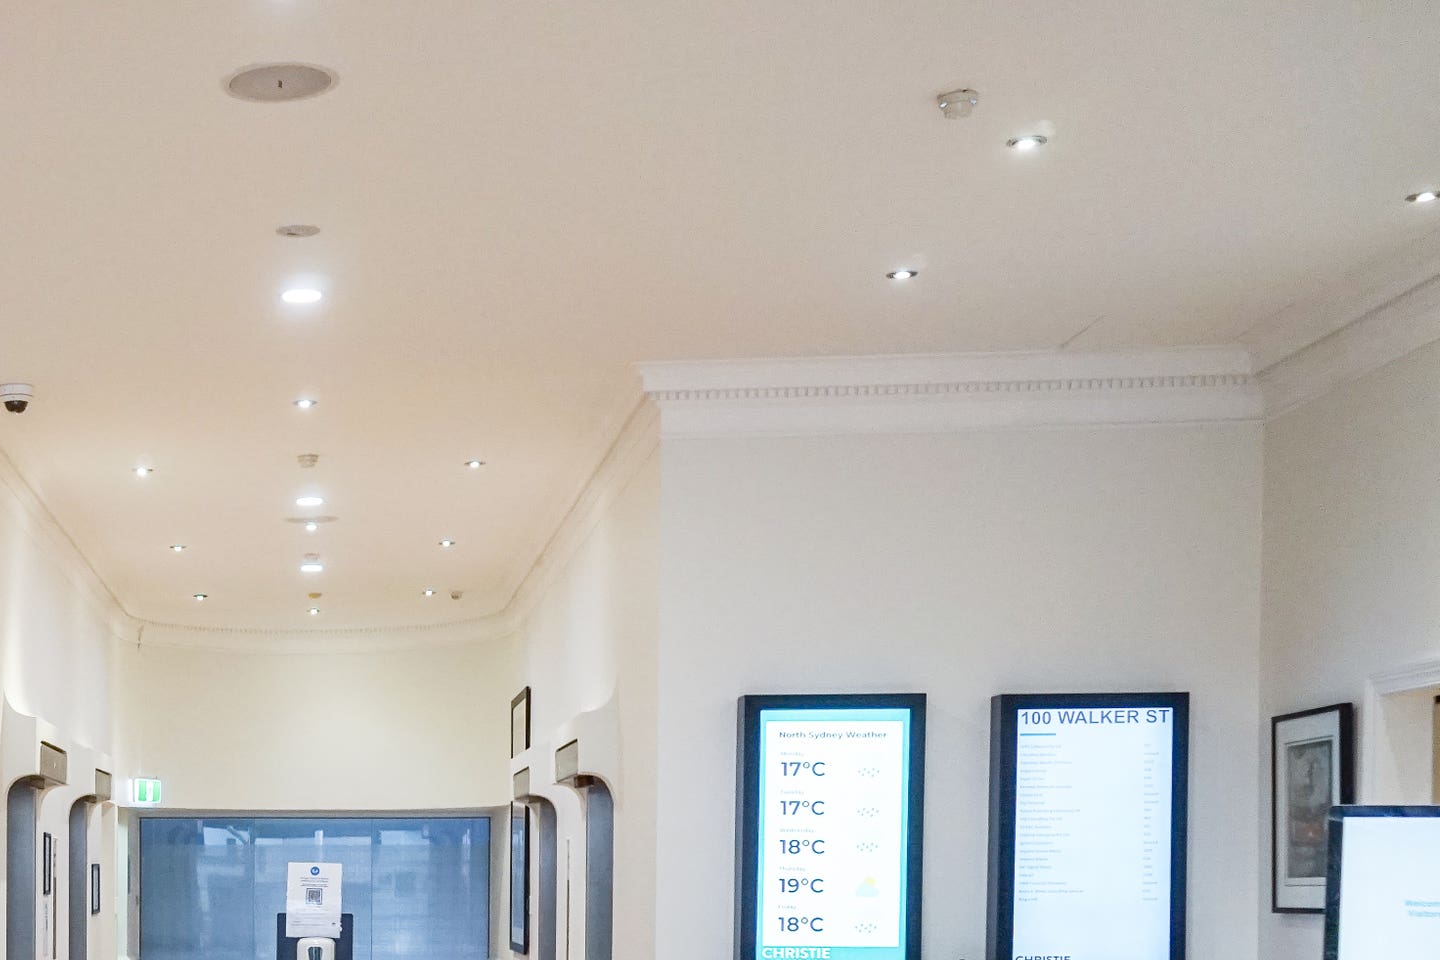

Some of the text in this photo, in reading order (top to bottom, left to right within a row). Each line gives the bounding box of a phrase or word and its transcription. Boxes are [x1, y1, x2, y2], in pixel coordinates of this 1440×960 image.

[1020, 708, 1170, 725] 100 WALKER ST
[778, 731, 888, 740] North Sydney Weather
[780, 761, 826, 777] 17°C
[780, 800, 825, 816] 17°C
[779, 839, 825, 855] 18°C
[778, 878, 824, 893] 19°C
[777, 916, 824, 932] 18°C
[761, 947, 831, 959] CHRISTIE
